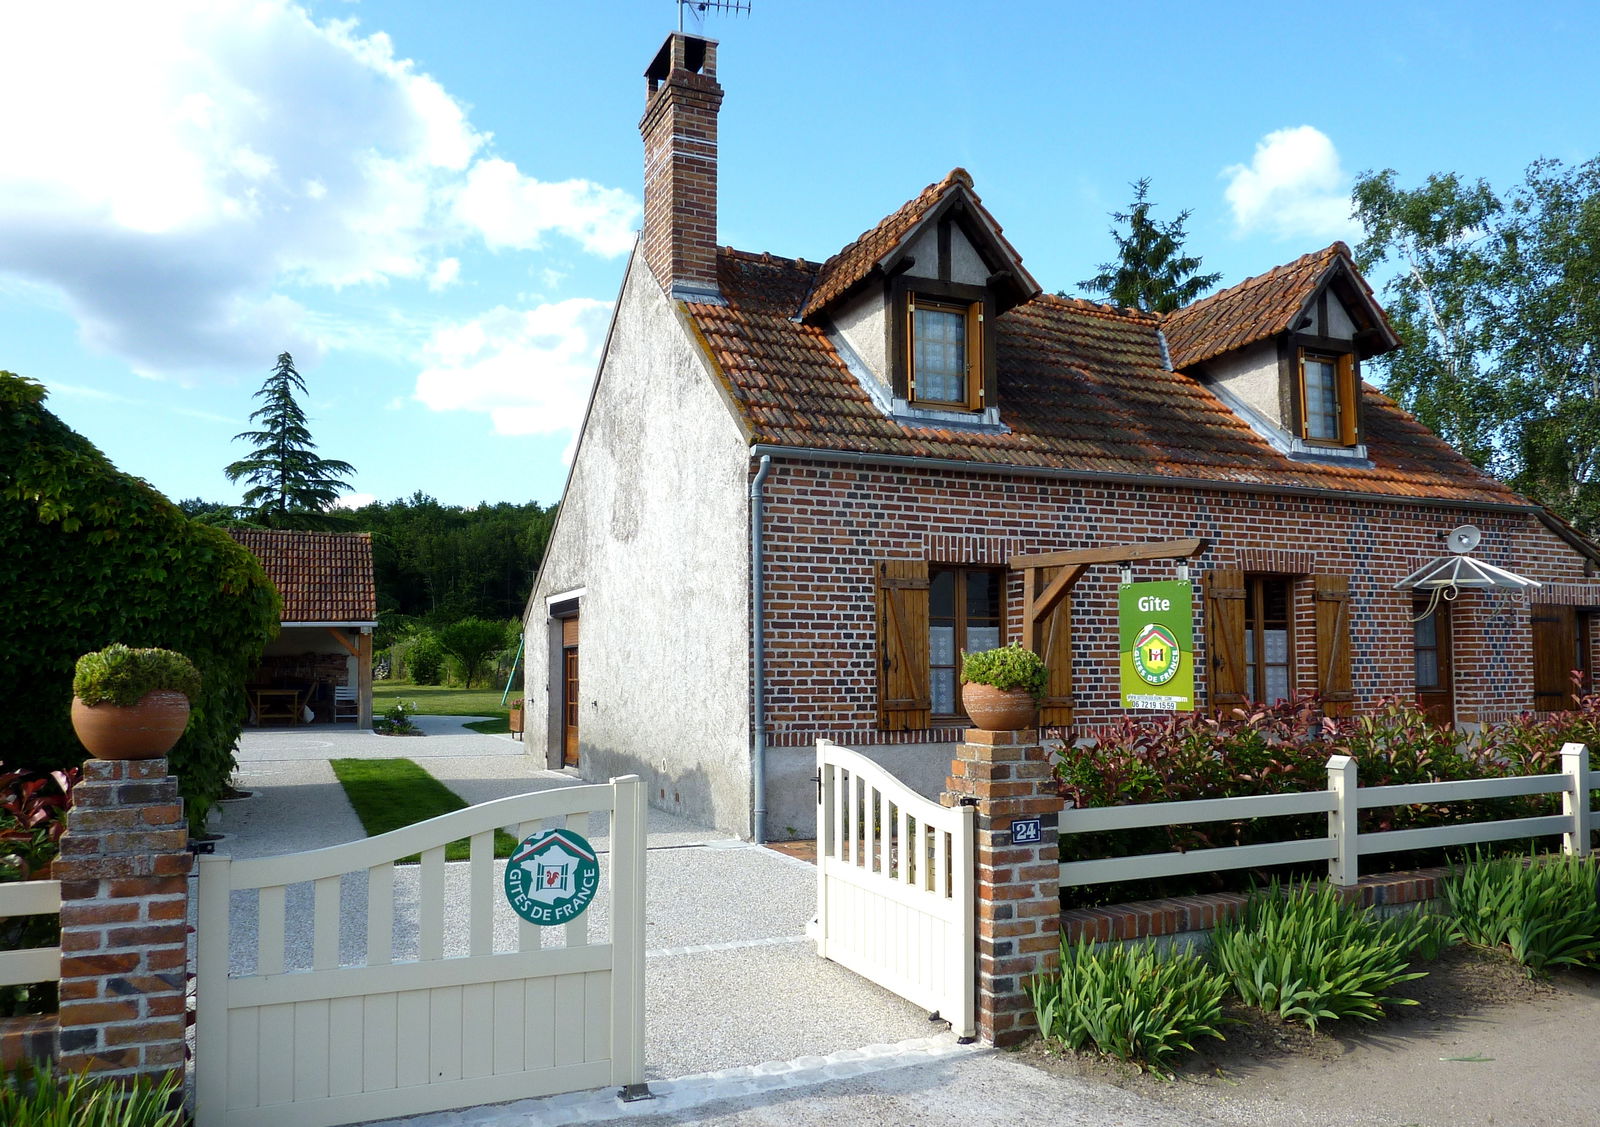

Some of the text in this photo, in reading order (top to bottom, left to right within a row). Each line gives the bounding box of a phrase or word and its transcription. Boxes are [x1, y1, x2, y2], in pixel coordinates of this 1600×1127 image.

[1138, 596, 1170, 612] Gîte
[1147, 674, 1158, 683] DE
[1159, 650, 1178, 682] FRANCE
[1016, 823, 1036, 840] 24
[509, 868, 595, 921] GITES DE FRANCE
